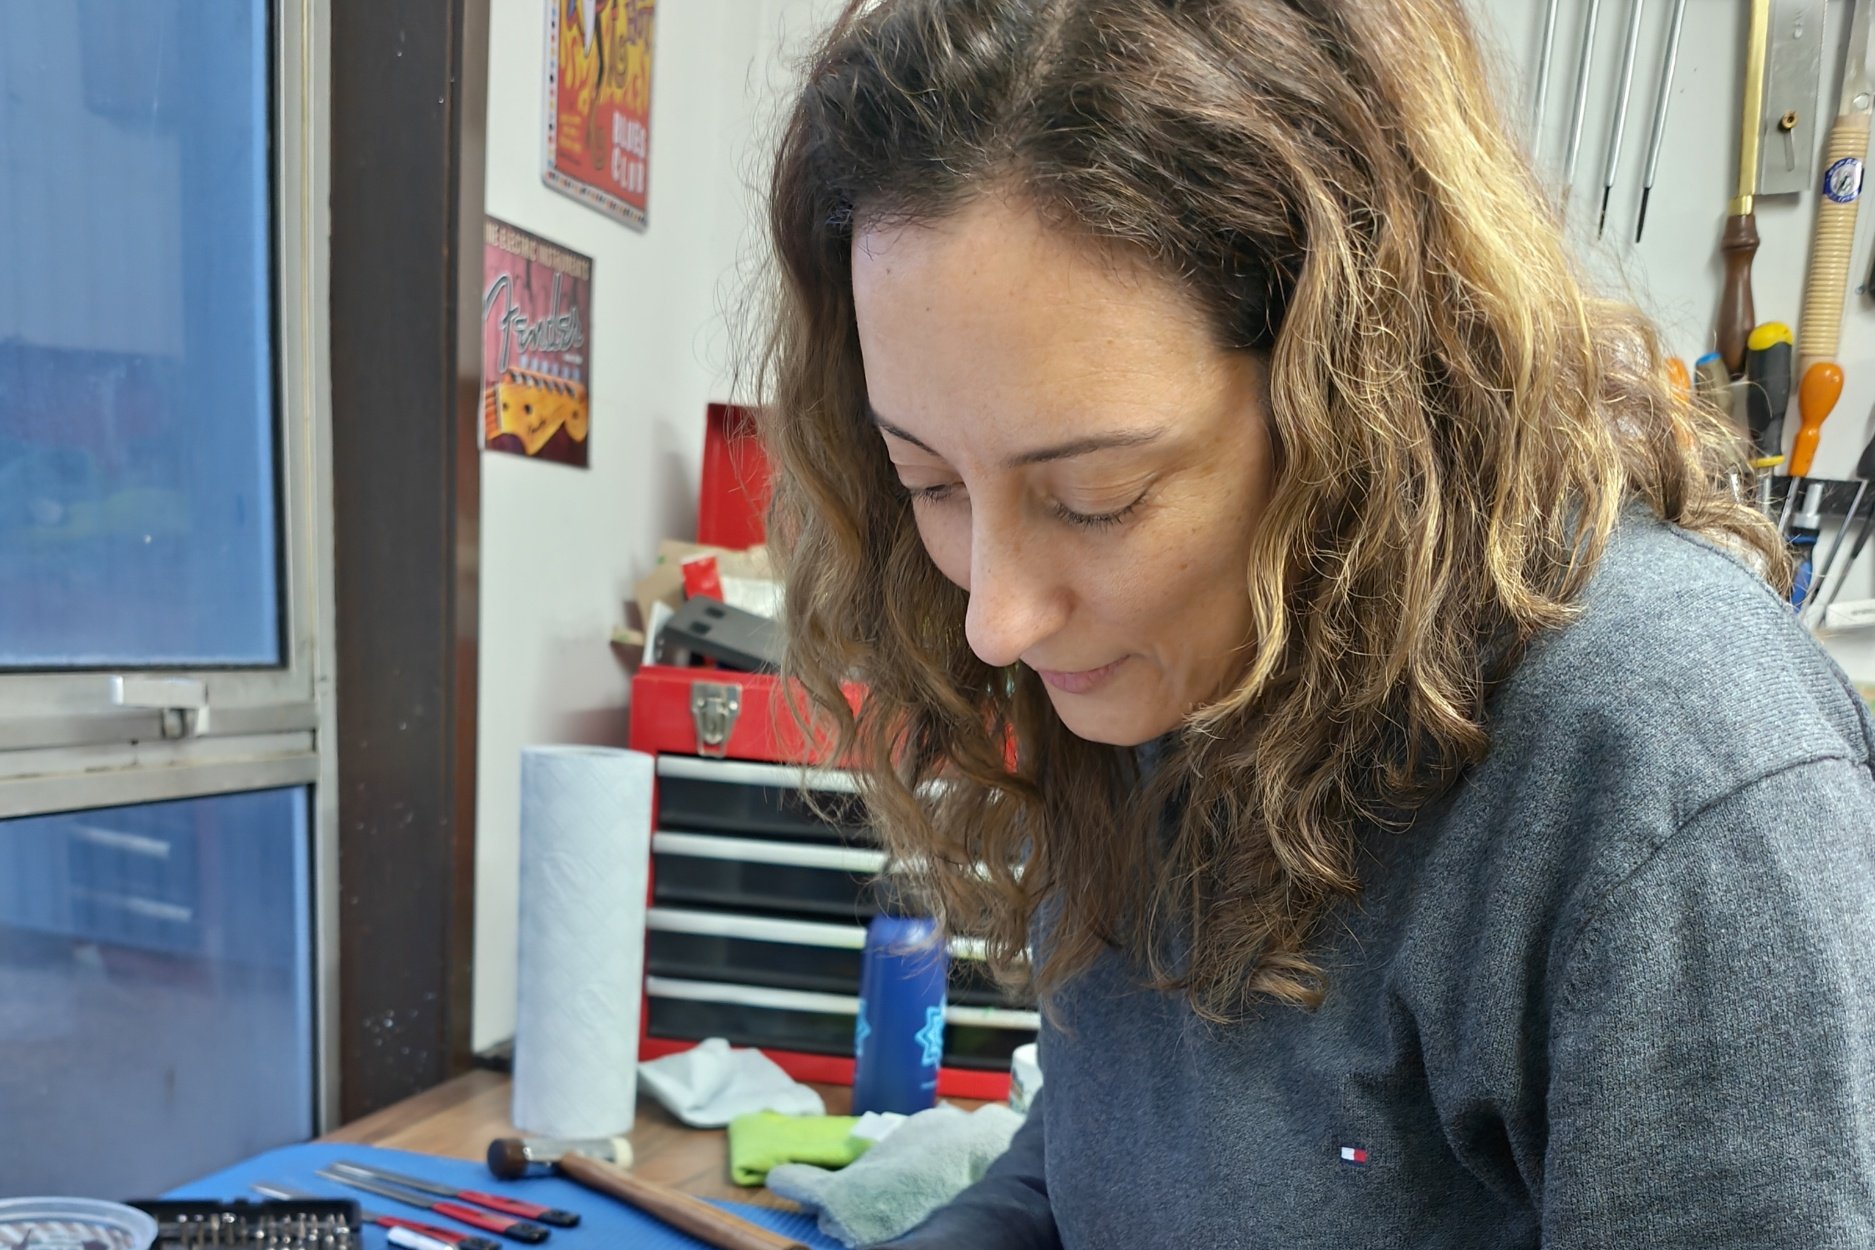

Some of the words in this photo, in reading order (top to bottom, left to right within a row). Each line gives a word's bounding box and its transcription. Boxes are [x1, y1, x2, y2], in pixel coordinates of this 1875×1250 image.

[612, 110, 646, 159] BLUES
[611, 146, 644, 194] CLUB
[482, 272, 583, 374] Fender
